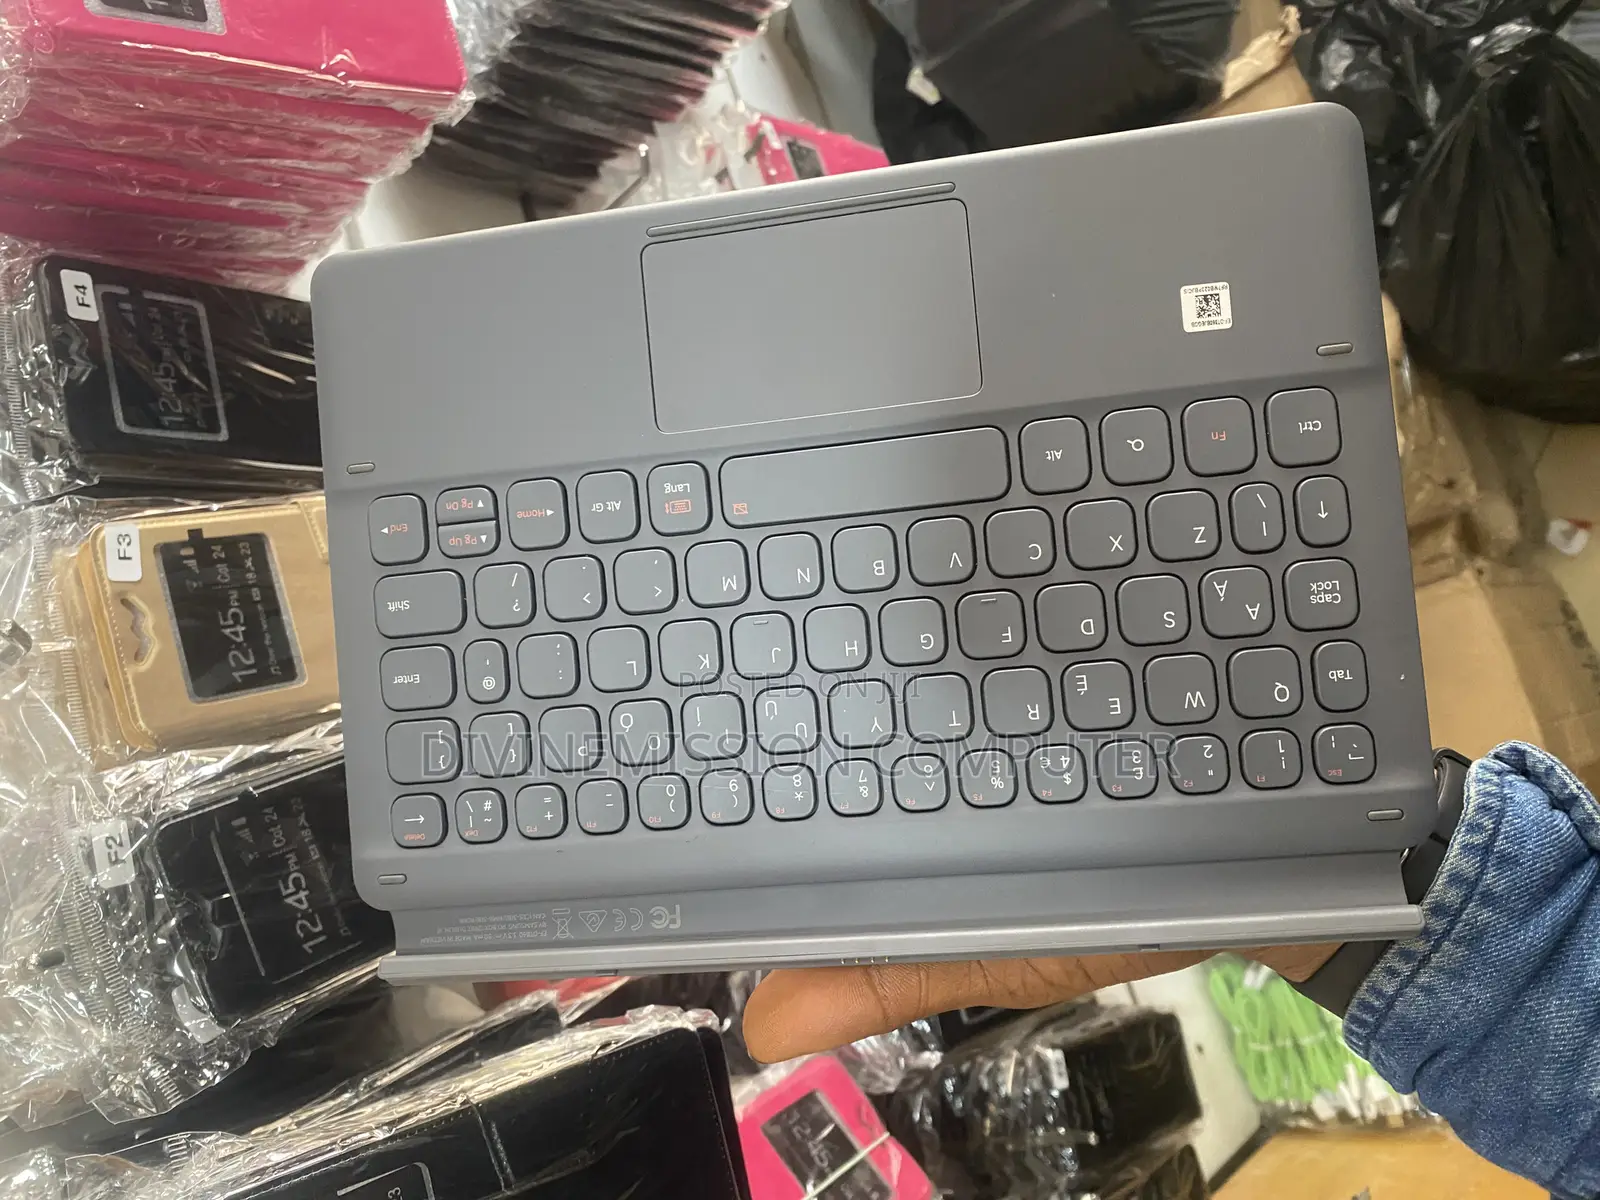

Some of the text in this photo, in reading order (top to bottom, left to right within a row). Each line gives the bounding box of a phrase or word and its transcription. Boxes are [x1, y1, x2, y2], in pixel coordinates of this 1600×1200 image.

[74, 284, 91, 308] F4
[1299, 421, 1321, 433] Ctrl
[1211, 431, 1226, 441] Fn
[1046, 450, 1062, 461] Alt
[664, 483, 690, 493] Lang
[461, 497, 472, 508] Pg
[591, 501, 621, 512] Alt Gr
[516, 510, 544, 518] Home
[390, 523, 408, 533] End
[1193, 527, 1206, 543] Z
[117, 533, 132, 560] F3
[448, 535, 477, 546] Pg Up
[1110, 535, 1123, 551] X
[211, 545, 225, 560] 24
[238, 541, 251, 556] 23
[1029, 544, 1041, 559] C
[873, 560, 884, 575] B
[950, 553, 962, 568] V
[797, 568, 810, 583] N
[723, 575, 736, 591] M
[1310, 581, 1339, 592] Lock
[1213, 580, 1227, 601] Á
[1310, 590, 1341, 603] Caps
[387, 600, 409, 612] Shift
[513, 600, 520, 611] ?
[1246, 603, 1260, 620] A
[1081, 619, 1094, 635] D
[1164, 612, 1175, 628] S
[921, 634, 933, 649] G
[1002, 627, 1011, 642] F
[218, 610, 257, 683] 12:45
[845, 641, 857, 656] H
[698, 654, 709, 669] K
[772, 648, 781, 663] J
[626, 661, 636, 675] L
[394, 674, 419, 683] Enter
[1329, 670, 1352, 681] Tab
[483, 677, 495, 690] @
[1076, 675, 1087, 695] É
[1275, 682, 1289, 702] Q
[1109, 698, 1121, 714] E
[1185, 691, 1205, 708] W
[765, 701, 777, 720] Ú
[1027, 704, 1039, 720] R
[620, 713, 633, 732] Ó
[871, 717, 882, 732] Y
[949, 711, 961, 726] T
[795, 723, 807, 738] U
[578, 741, 588, 755] P
[648, 735, 660, 750] O
[1278, 739, 1285, 752] 1
[1132, 750, 1141, 763] 3
[1203, 745, 1213, 758] 2
[992, 760, 1000, 773] 5
[1040, 757, 1051, 768] €
[1060, 756, 1070, 768] 4
[859, 770, 867, 782] 7
[924, 765, 933, 778] 6
[1063, 773, 1071, 784] $
[1133, 767, 1143, 779] £
[1328, 768, 1342, 776] Esc
[729, 779, 738, 791] 9
[793, 773, 801, 787] 8
[991, 777, 1004, 788] %
[664, 784, 675, 796] 0
[859, 786, 868, 797] &
[484, 800, 492, 811] #
[105, 833, 127, 866] F2
[278, 871, 328, 954] 12:45
